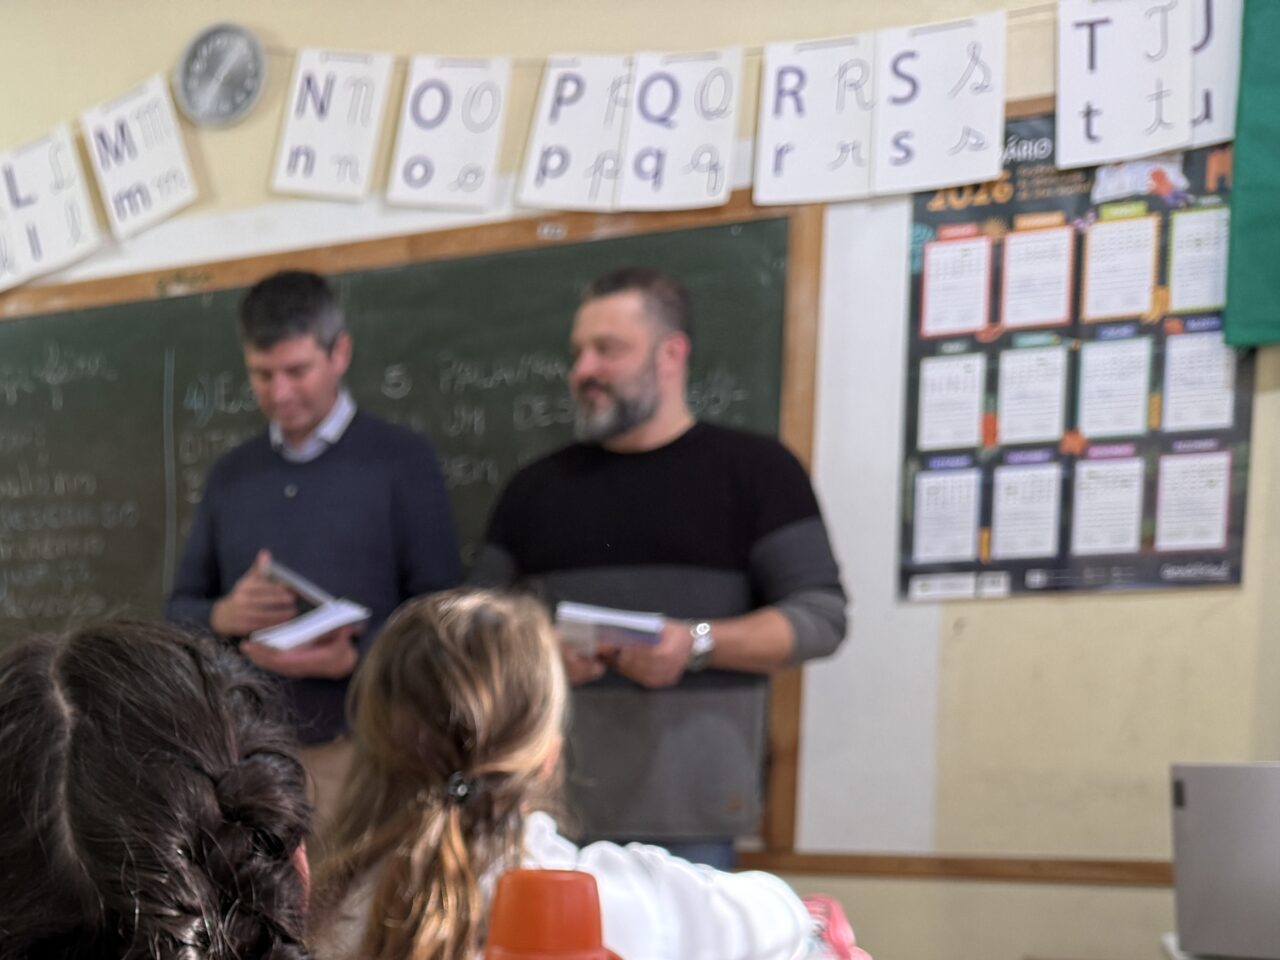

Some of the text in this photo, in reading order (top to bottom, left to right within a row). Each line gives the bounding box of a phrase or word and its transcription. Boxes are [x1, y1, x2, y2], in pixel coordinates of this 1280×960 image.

[1073, 18, 1112, 73] T
[295, 71, 335, 120] N
[548, 71, 586, 125] P
[637, 70, 682, 131] Q
[773, 65, 807, 118] R
[888, 50, 920, 106] S
[410, 78, 452, 130] O
[1079, 101, 1103, 142] t
[94, 116, 139, 171] M
[286, 145, 316, 179] n
[534, 144, 572, 188] p
[772, 141, 795, 177] r
[889, 131, 915, 167] s
[3, 163, 38, 209] L
[402, 155, 436, 190] o
[633, 145, 667, 191] q
[113, 182, 152, 221] m
